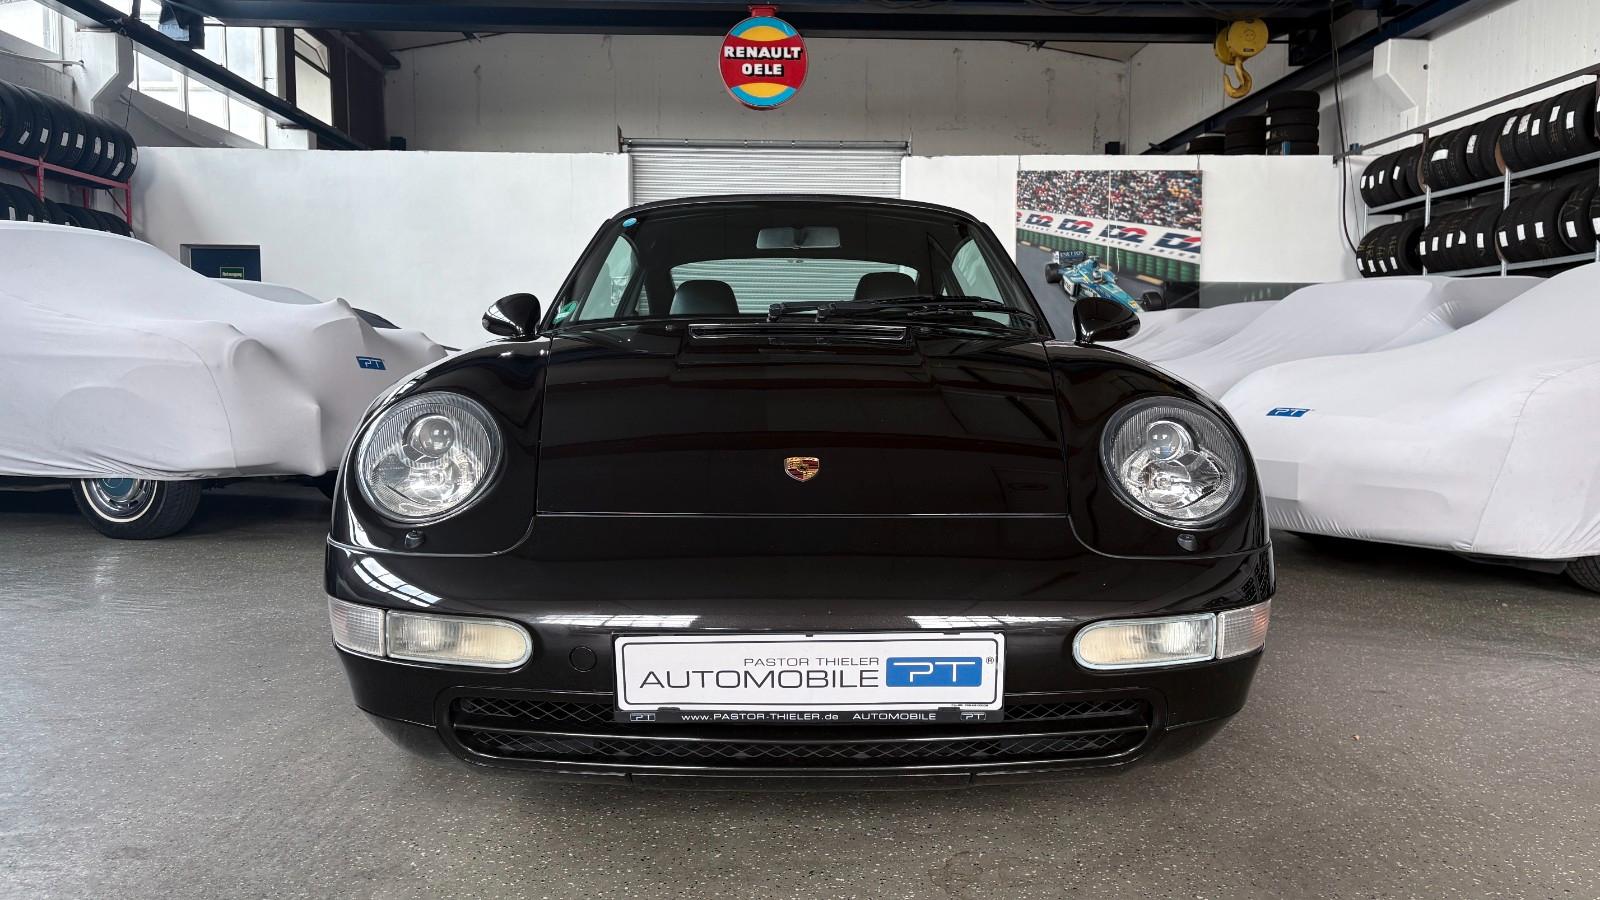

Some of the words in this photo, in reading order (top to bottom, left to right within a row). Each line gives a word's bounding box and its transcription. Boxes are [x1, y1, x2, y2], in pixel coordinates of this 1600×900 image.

[724, 46, 802, 59] RENAULT
[741, 63, 783, 75] OELE
[1058, 218, 1094, 234] D2
[1099, 224, 1148, 243] D2
[1275, 408, 1307, 416] PT
[744, 657, 809, 667] PASTOR
[816, 656, 880, 666] THIELER
[893, 661, 976, 683] PT
[639, 669, 880, 689] AUTOMOBILE
[681, 712, 839, 721] www.PASTOR-THIELER.de
[852, 712, 937, 721] AUTOMOBILE
